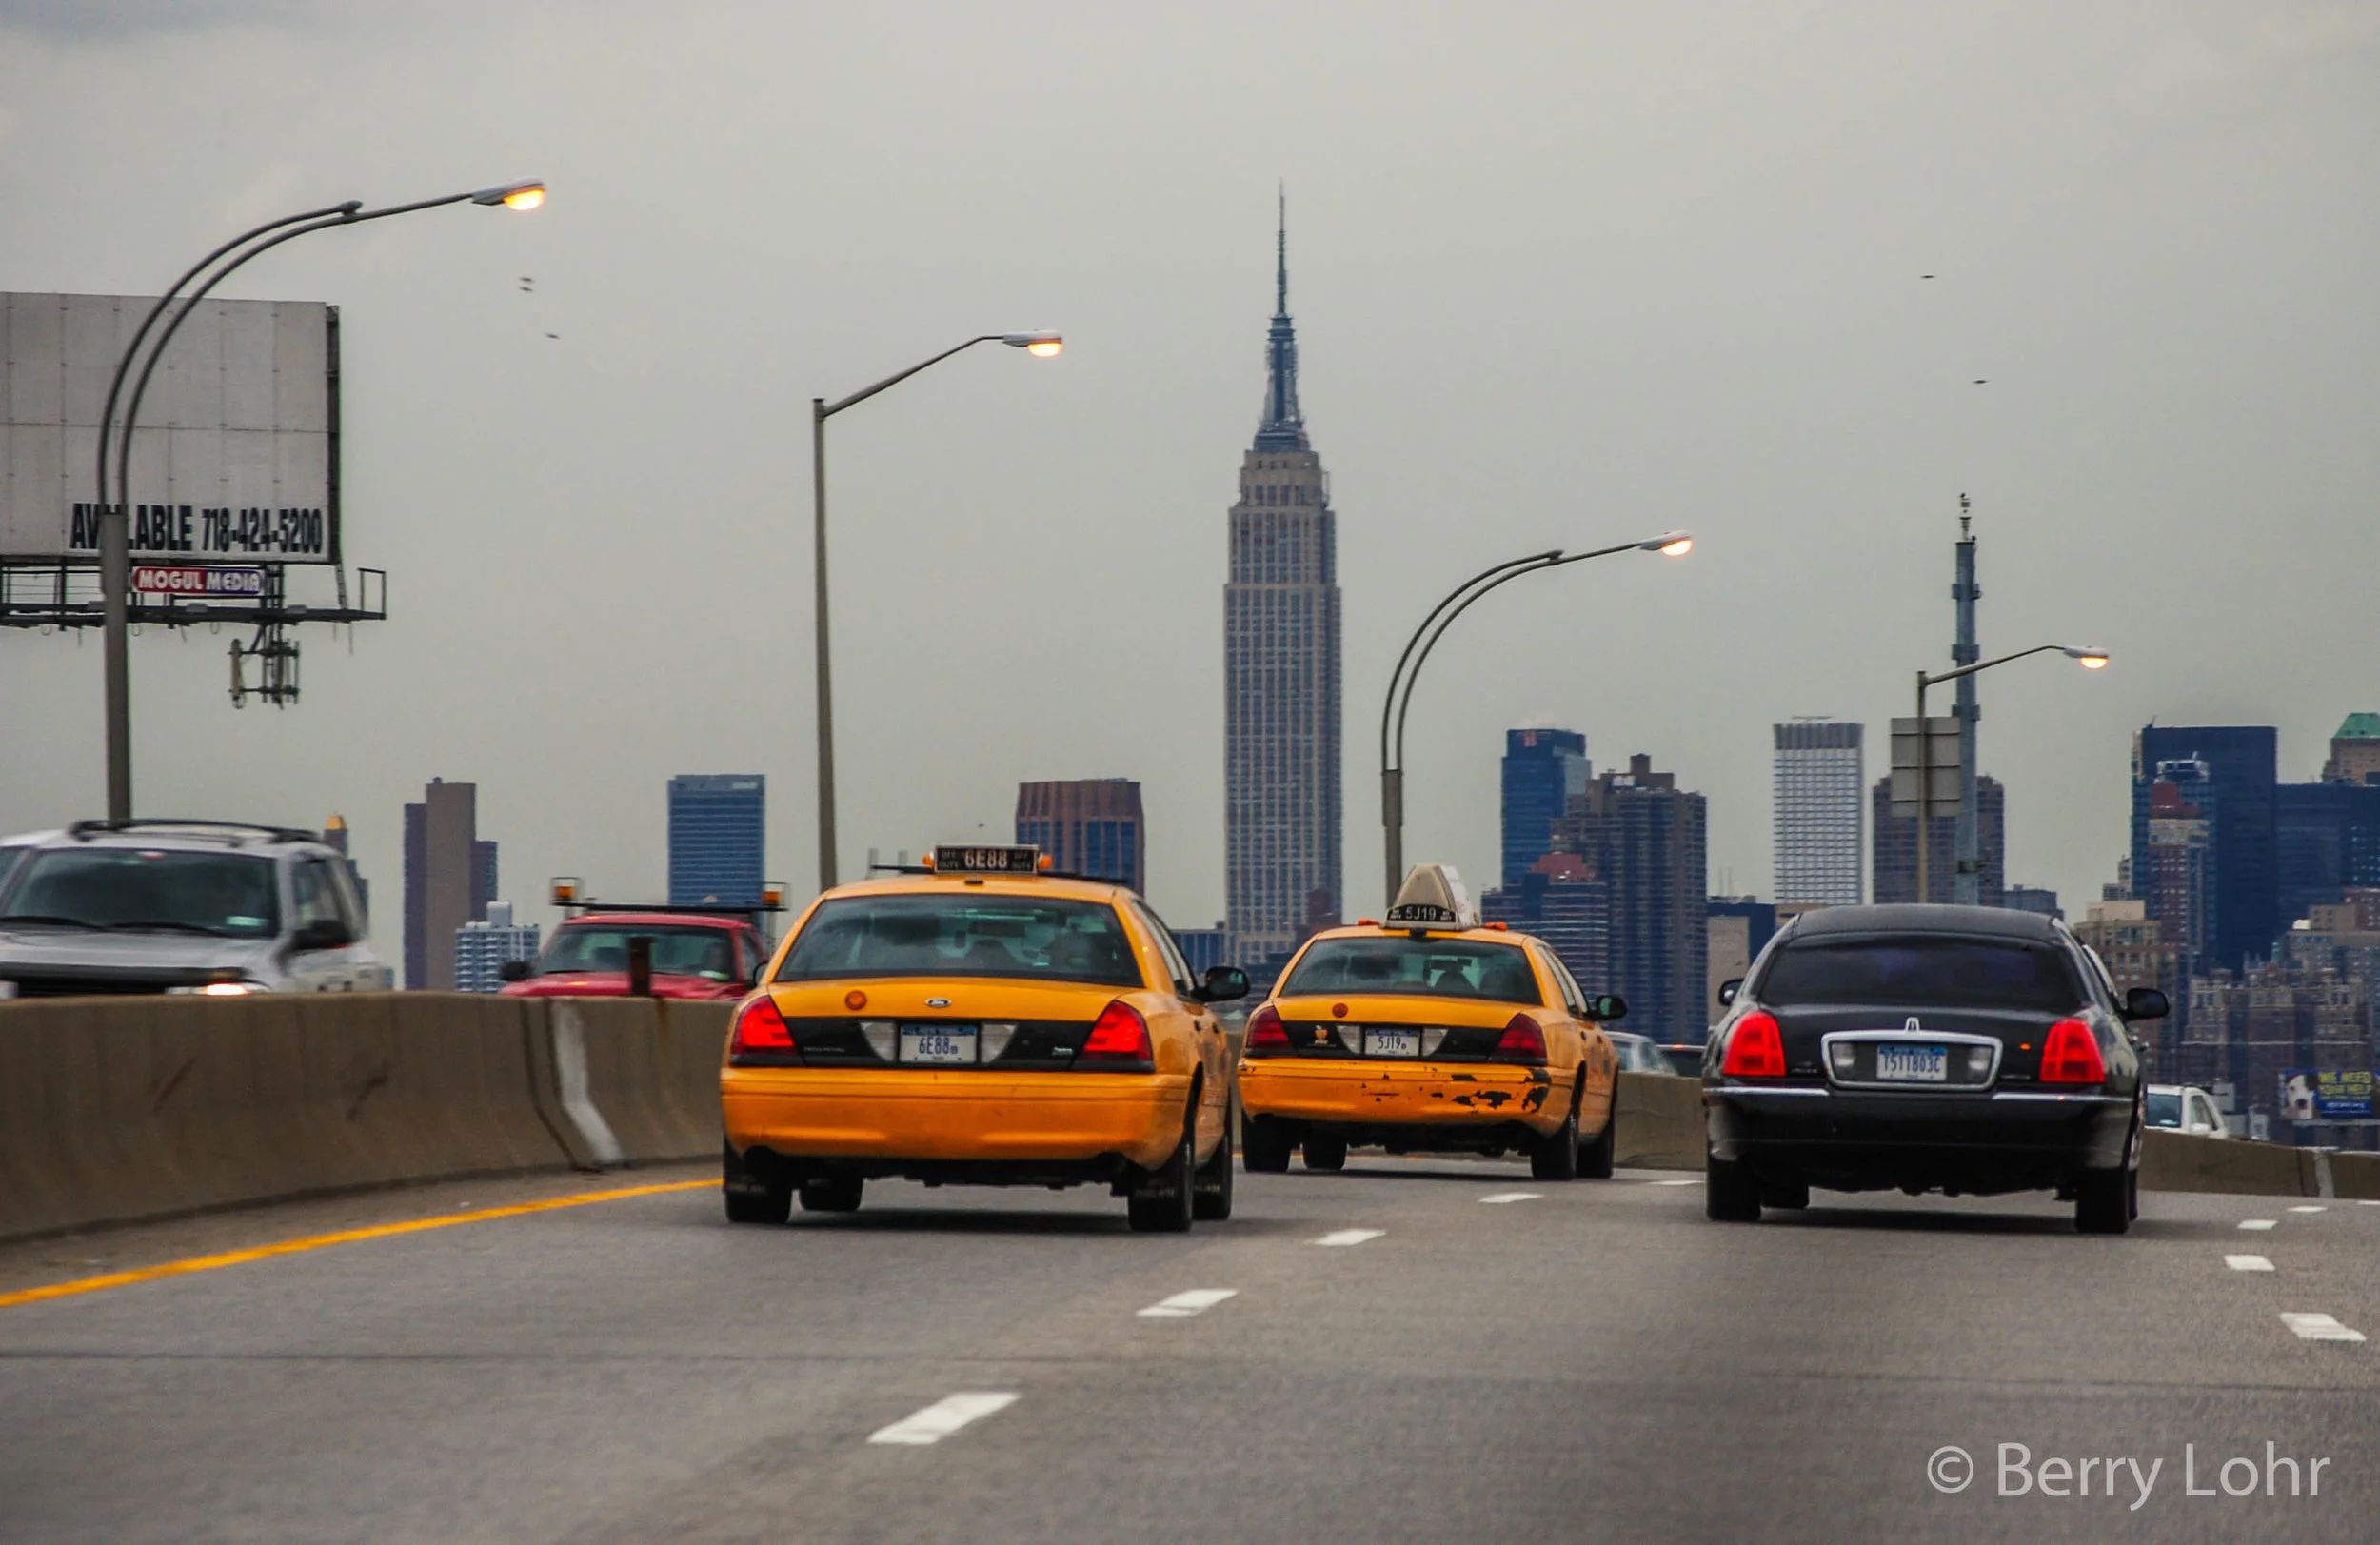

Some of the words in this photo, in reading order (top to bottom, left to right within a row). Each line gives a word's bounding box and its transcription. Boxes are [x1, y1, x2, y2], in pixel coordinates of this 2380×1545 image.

[69, 503, 194, 551] AVABLE
[201, 507, 323, 554] 718-424-5200
[138, 569, 204, 591] MOGUL
[207, 571, 261, 592] MEDIA
[964, 848, 1008, 869] 6E88
[1405, 905, 1437, 921] 5J19
